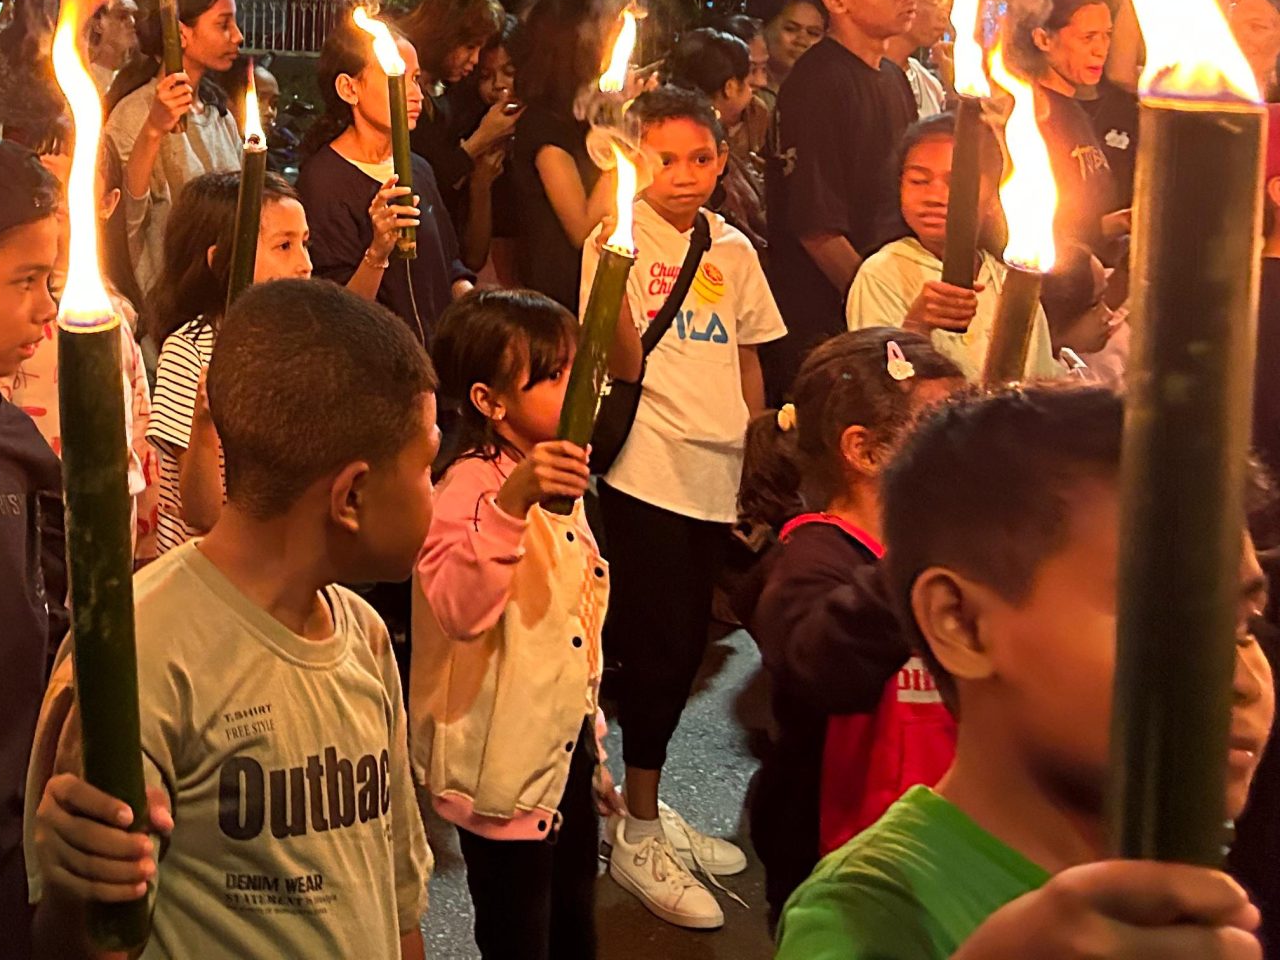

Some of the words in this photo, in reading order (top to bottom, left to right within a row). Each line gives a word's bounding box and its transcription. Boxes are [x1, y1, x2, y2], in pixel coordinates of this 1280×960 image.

[647, 308, 728, 344] ILA
[225, 723, 251, 741] FREE
[251, 719, 275, 735] STYLE
[225, 872, 279, 892] DENIM
[285, 873, 323, 893] WEAR
